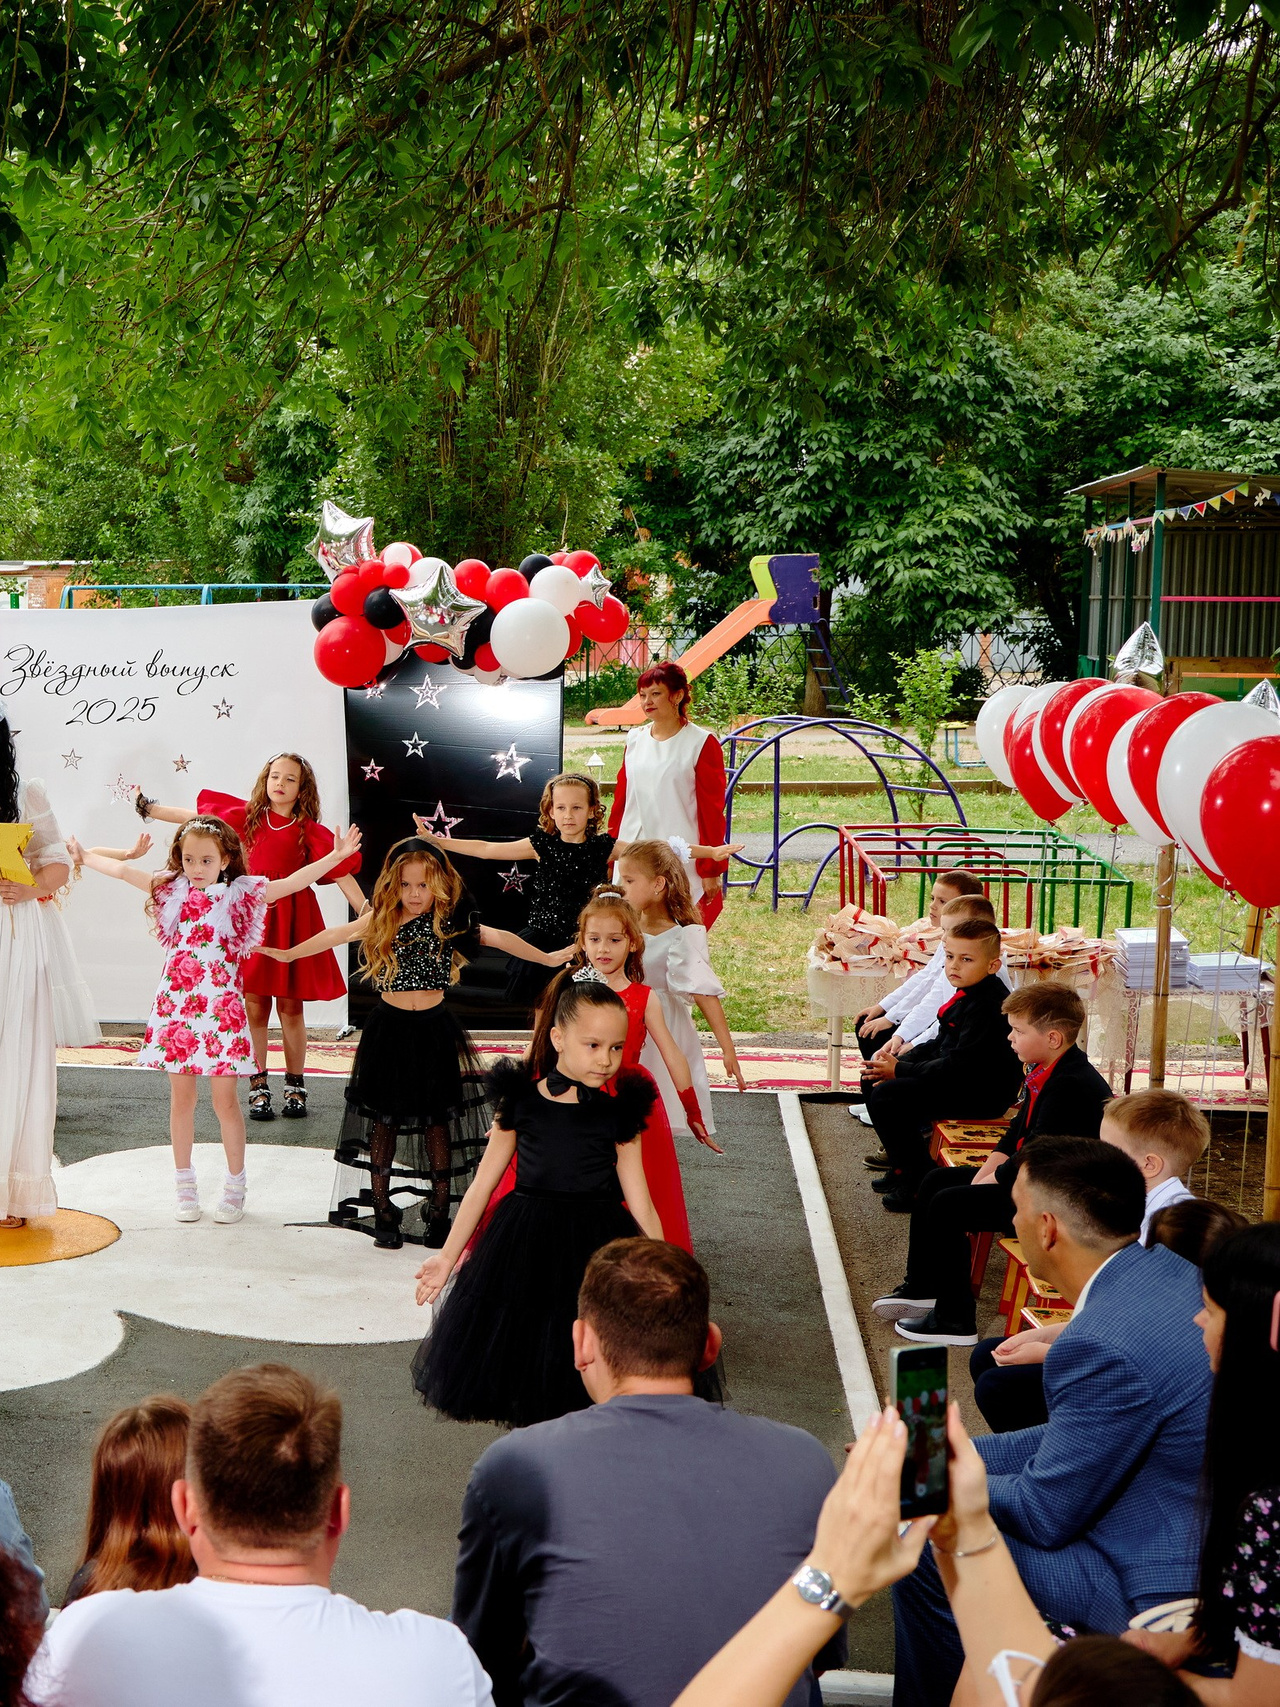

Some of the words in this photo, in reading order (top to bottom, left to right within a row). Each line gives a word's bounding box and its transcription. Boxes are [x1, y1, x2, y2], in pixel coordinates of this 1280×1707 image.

[0, 644, 138, 696] Звёздный
[146, 649, 240, 696] выпуск
[65, 696, 160, 726] 2025
